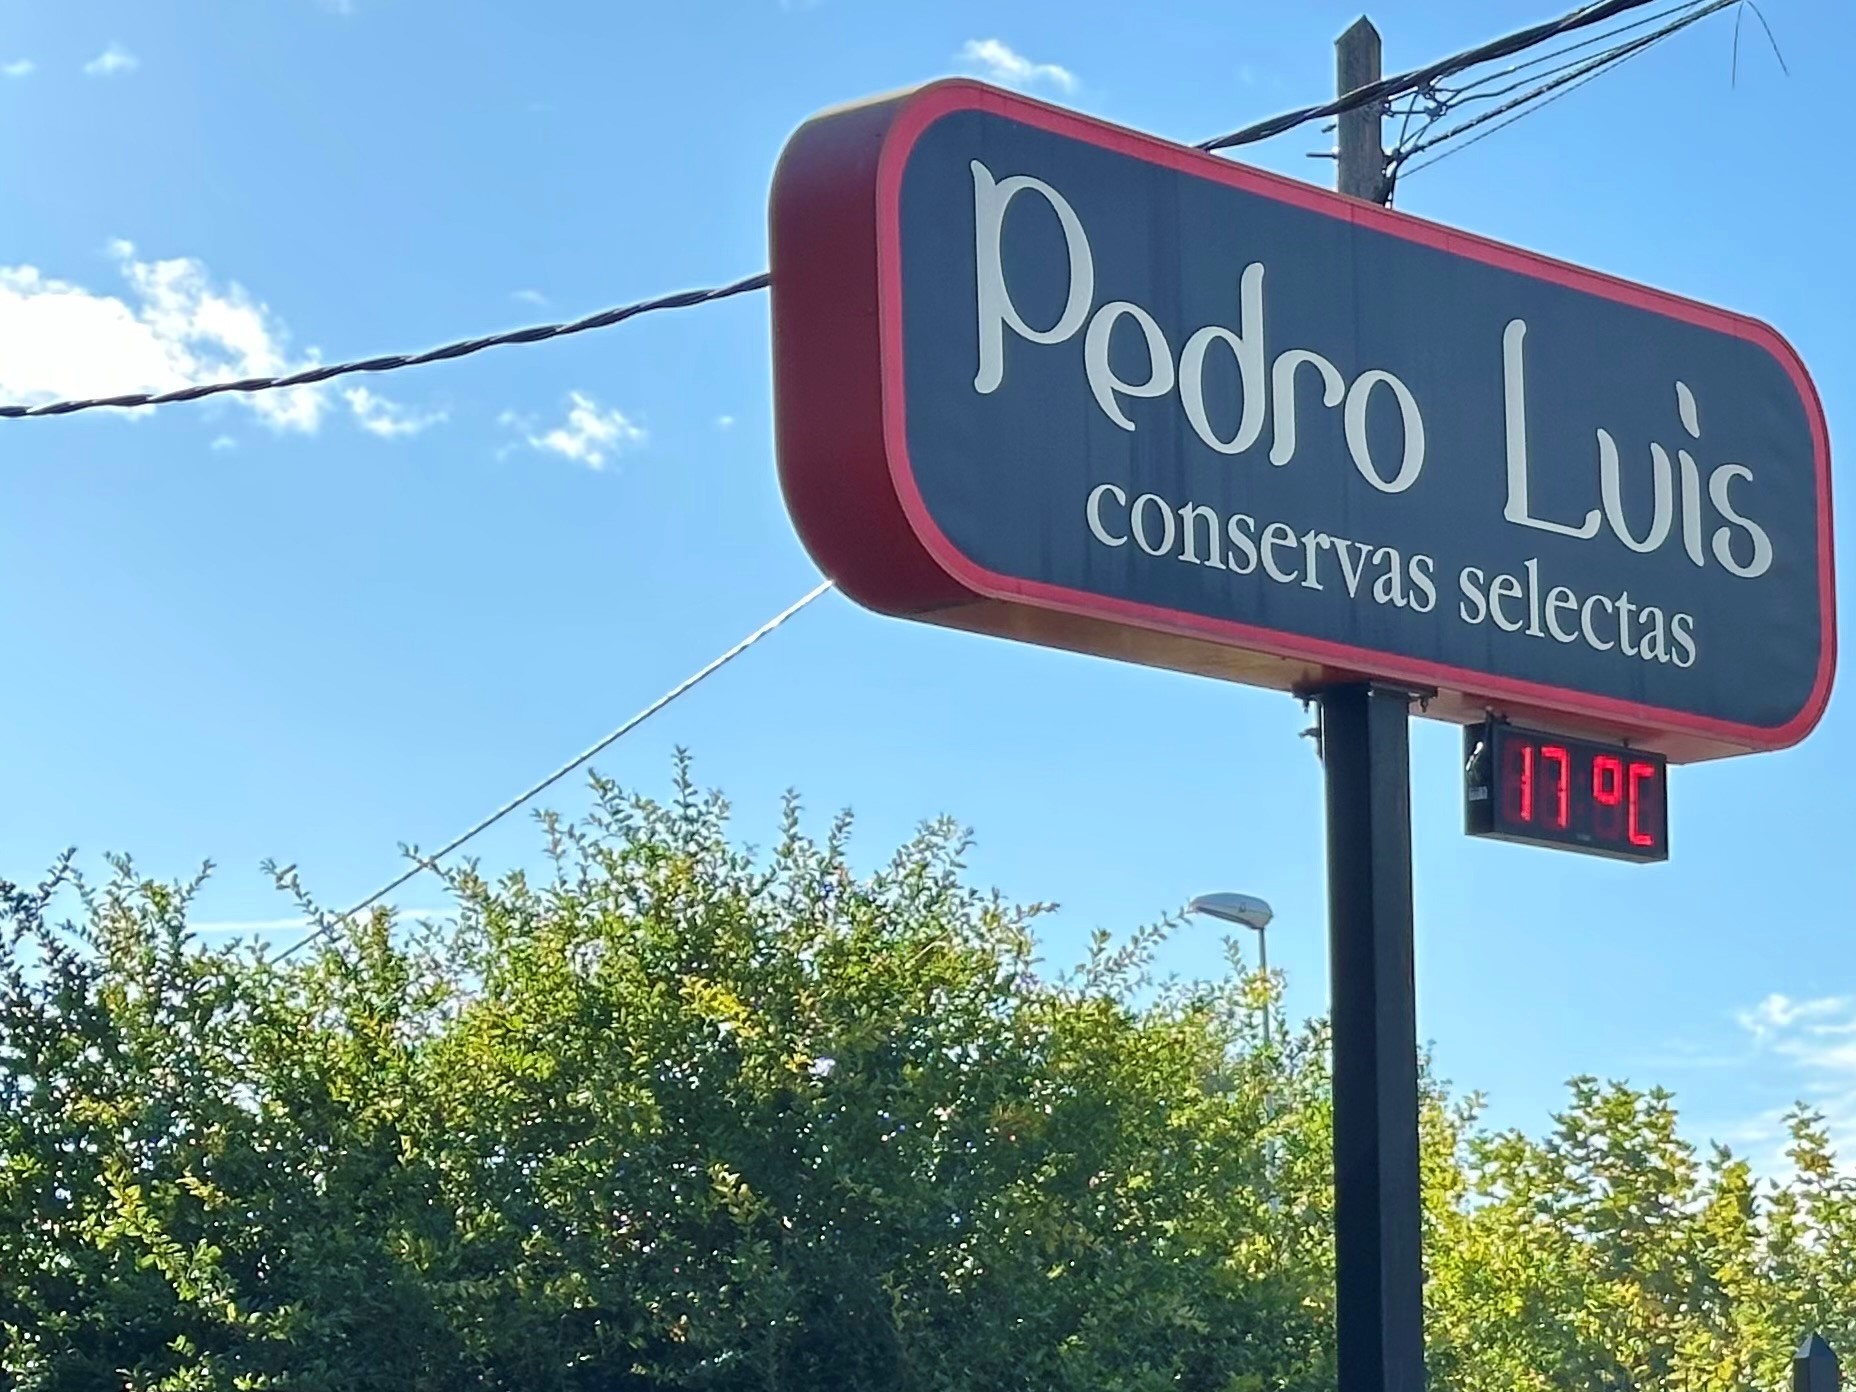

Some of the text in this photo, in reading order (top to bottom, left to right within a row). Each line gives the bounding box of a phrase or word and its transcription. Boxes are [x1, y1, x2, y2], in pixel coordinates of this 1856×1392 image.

[970, 160, 1773, 578] Pedro Luis
[1086, 483, 1697, 669] conservas selectas
